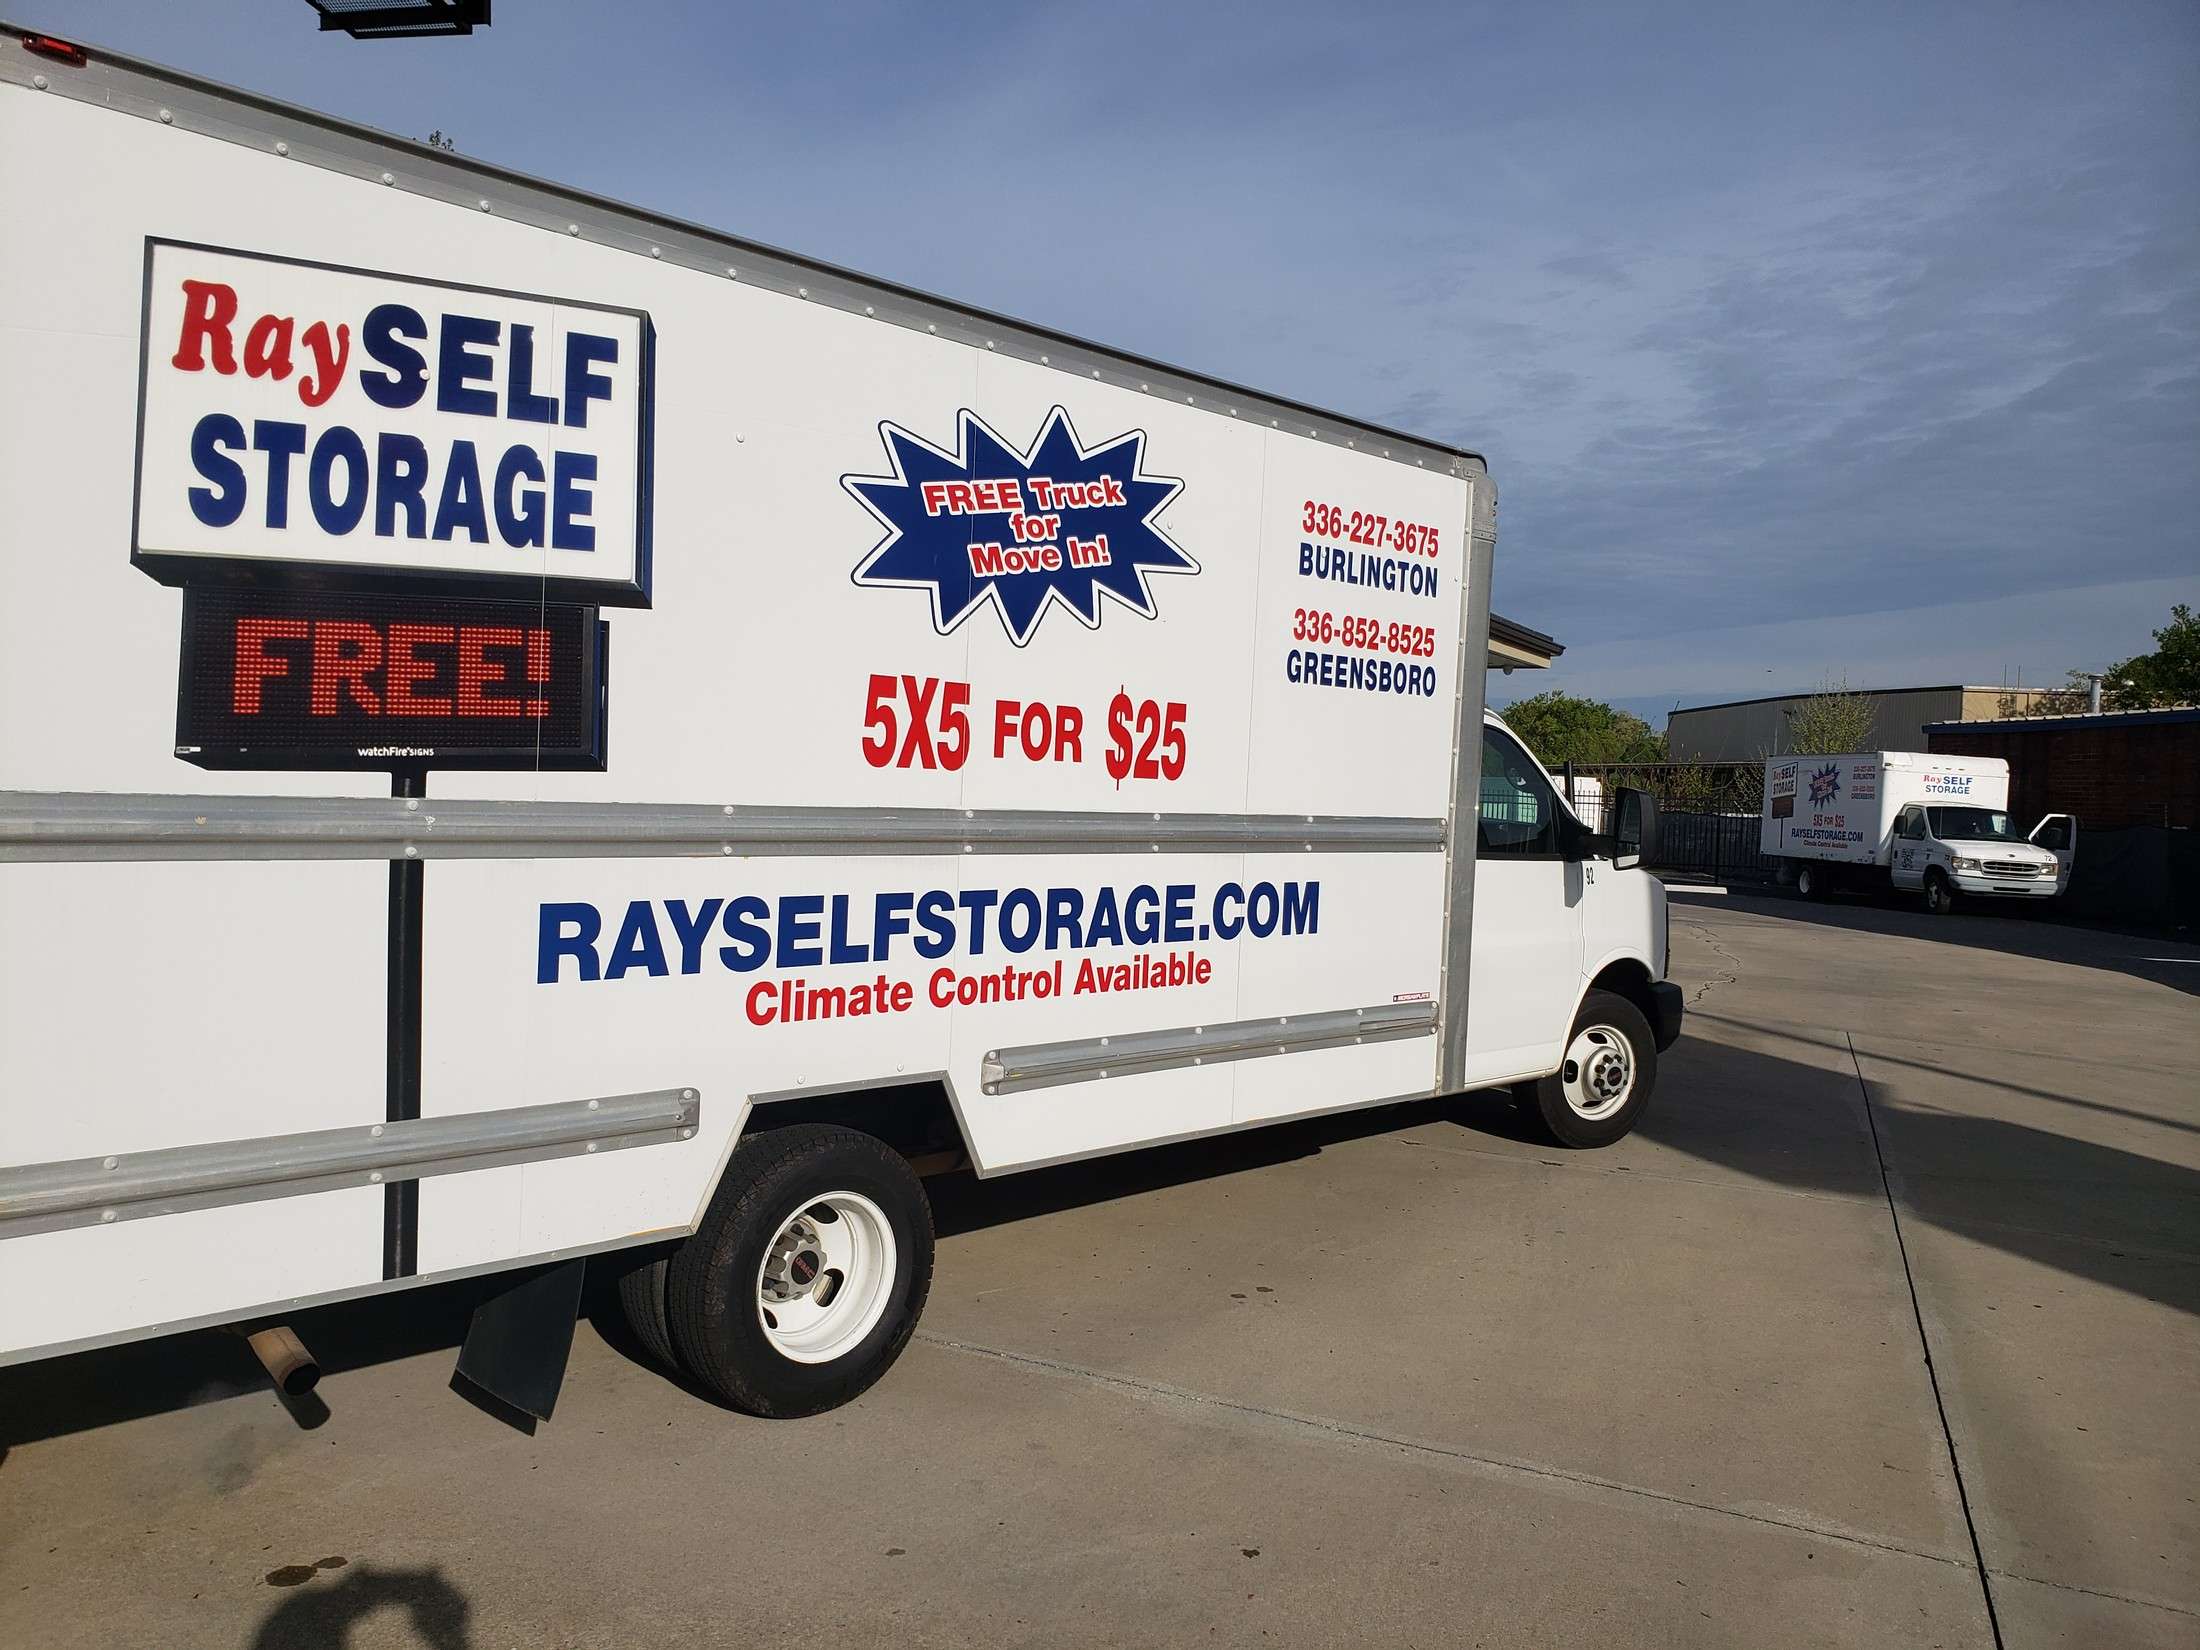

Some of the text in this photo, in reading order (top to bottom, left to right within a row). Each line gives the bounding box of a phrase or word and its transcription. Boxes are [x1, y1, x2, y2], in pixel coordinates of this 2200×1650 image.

[188, 412, 597, 553] STORAGE
[922, 477, 1124, 514] FREE Truck
[1011, 512, 1058, 540] for
[1302, 500, 1439, 558] 336-227-3675
[969, 536, 1110, 575] Move In!
[1298, 542, 1438, 598] BURLINGTON
[1293, 607, 1435, 657] 336-852-8525
[232, 617, 551, 718] FREE!
[1287, 650, 1436, 698] GREENSBORO
[861, 674, 1188, 791] 5X5 FOR $25
[1925, 784, 1971, 795] STORAGE
[1943, 776, 1973, 786] SELF
[1791, 828, 1864, 842] RAYSELFSTORAGE.COM
[1585, 866, 1594, 885] 92
[537, 880, 1320, 985] RAYSELFSTORAGE.COM
[745, 950, 1213, 1027] Climate Control Available
